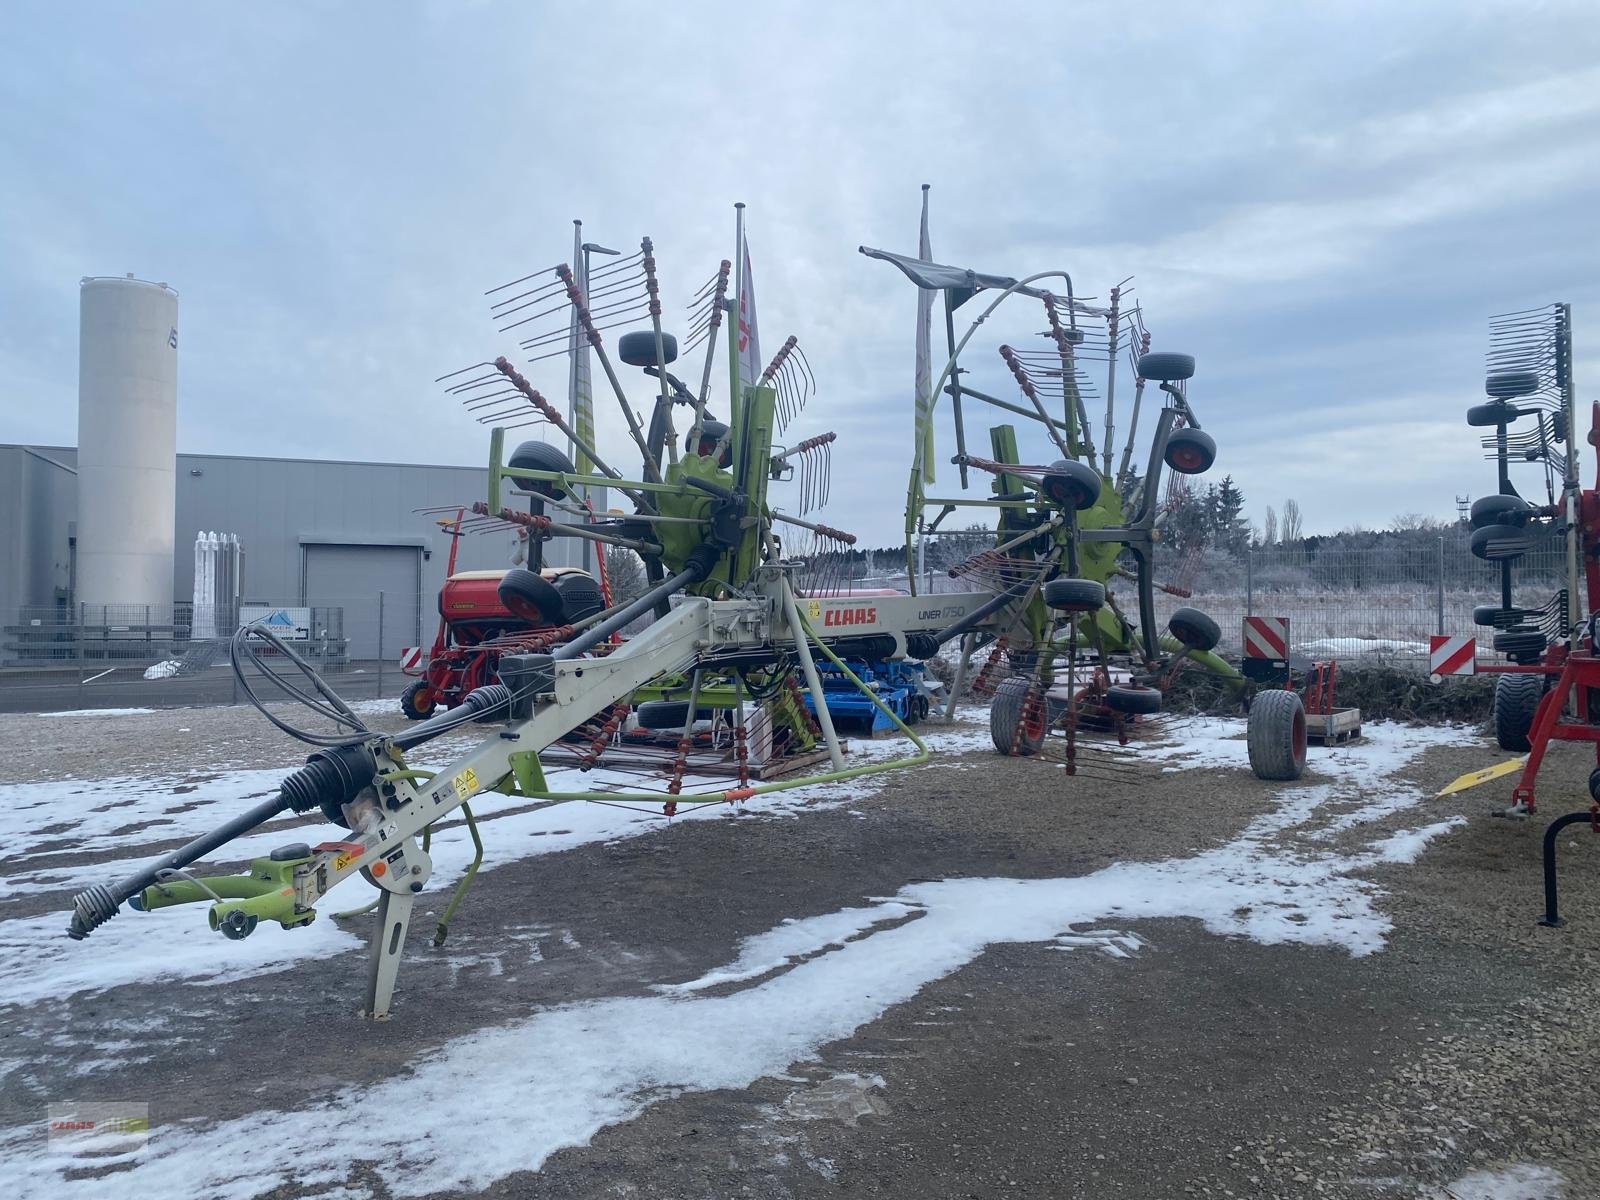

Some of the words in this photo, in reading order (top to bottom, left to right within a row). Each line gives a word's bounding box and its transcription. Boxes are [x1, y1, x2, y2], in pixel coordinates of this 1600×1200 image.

[824, 608, 876, 627] CLAAS
[918, 609, 941, 621] LINER
[942, 606, 965, 618] 1750
